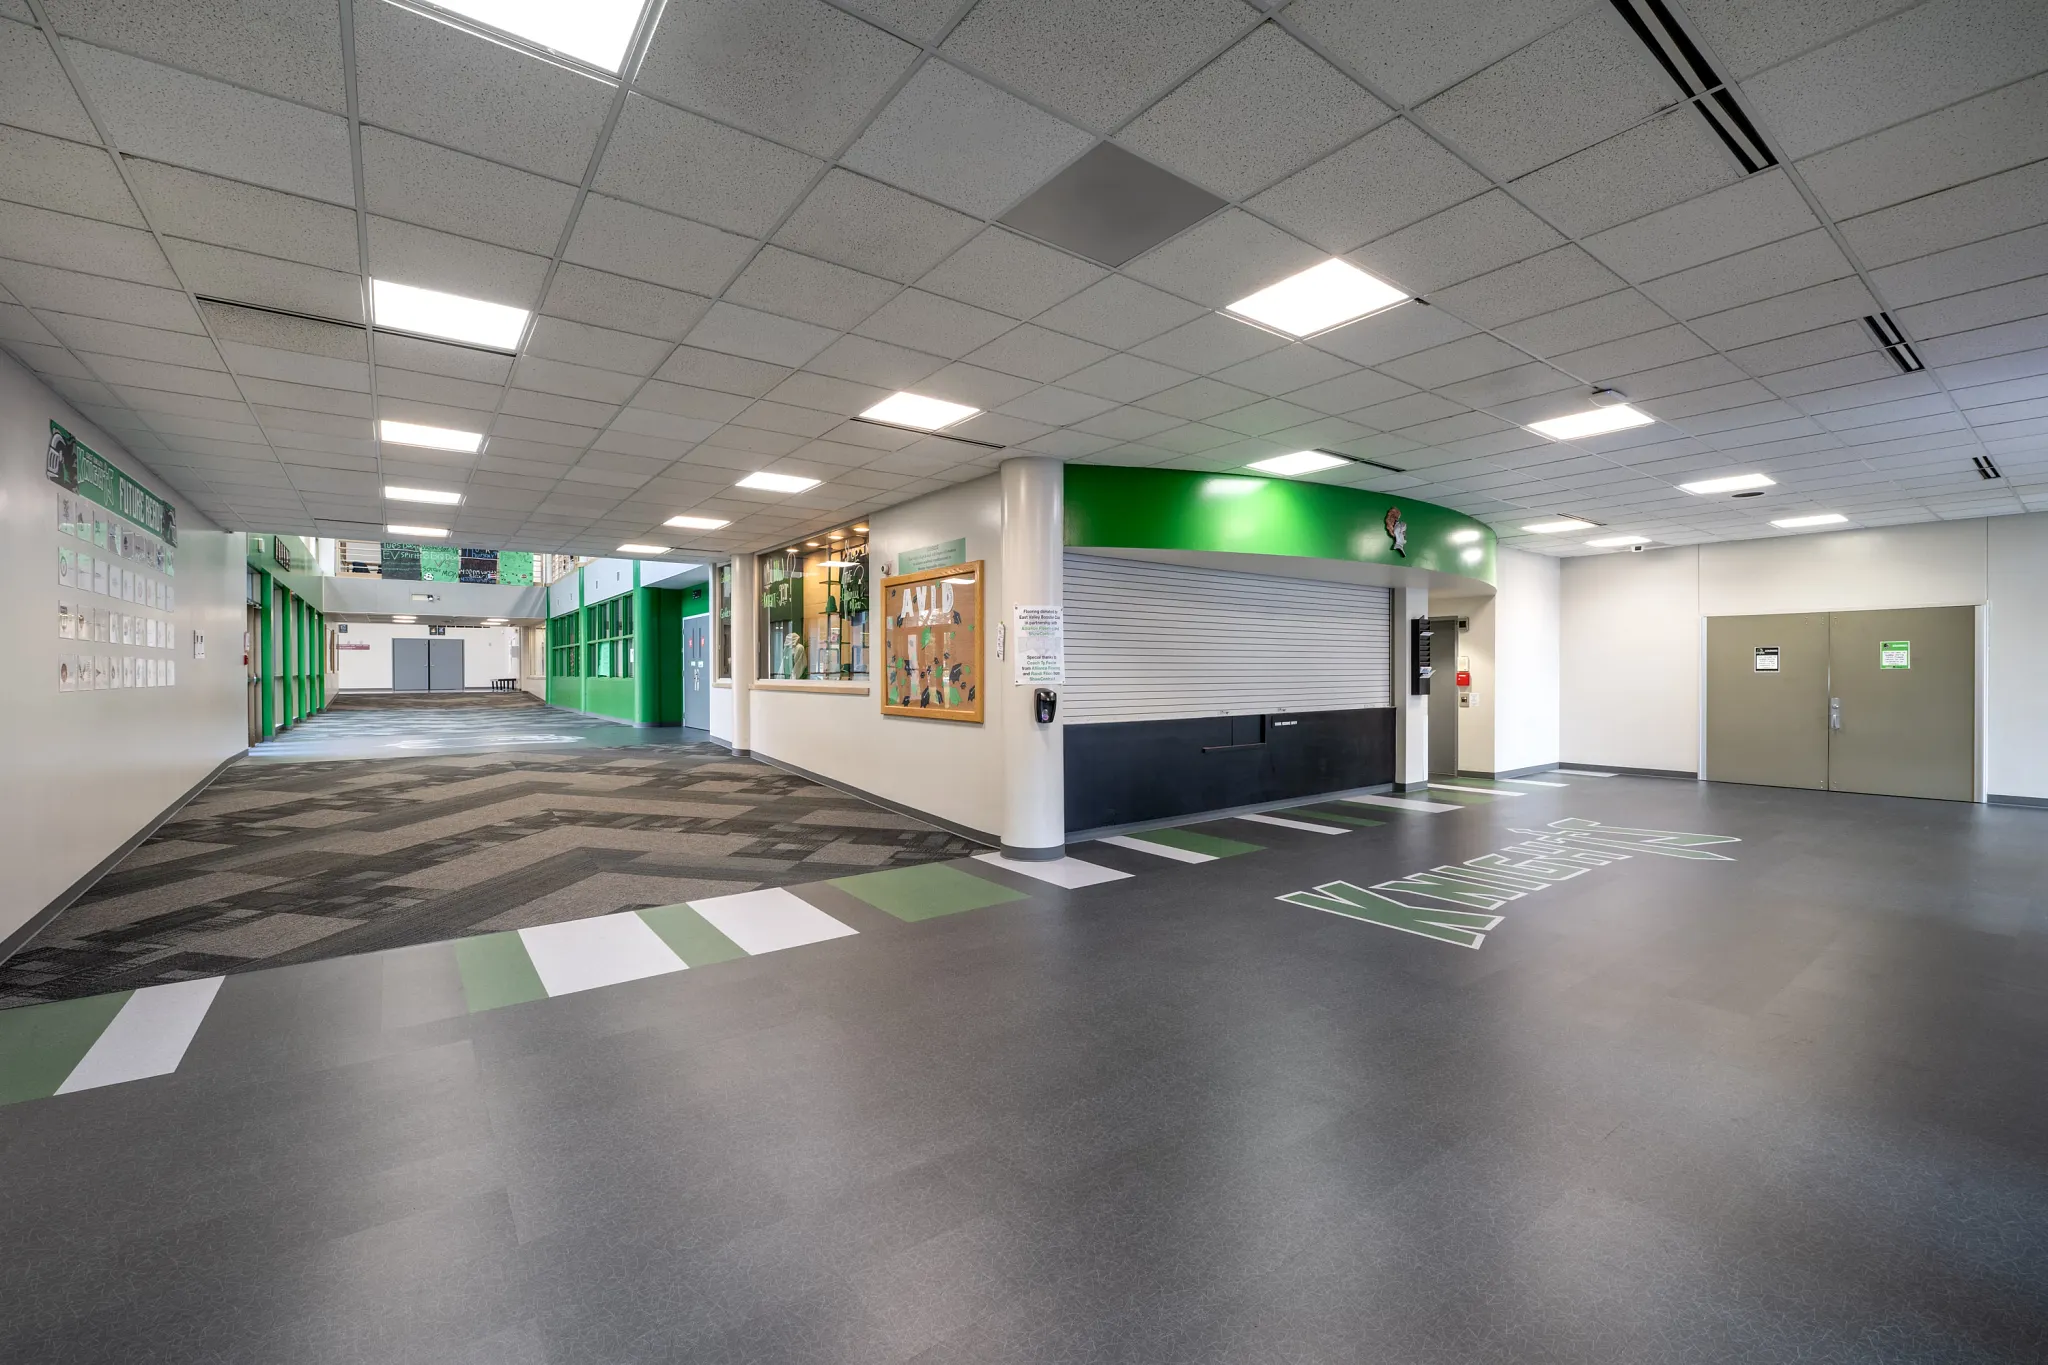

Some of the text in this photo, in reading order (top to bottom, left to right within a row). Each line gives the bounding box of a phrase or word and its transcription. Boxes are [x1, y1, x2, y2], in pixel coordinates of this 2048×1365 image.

[120, 476, 163, 534] FUTURE READY
[383, 550, 400, 560] EV
[901, 581, 954, 618] AVID
[1274, 816, 1743, 951] KNIGHTS
